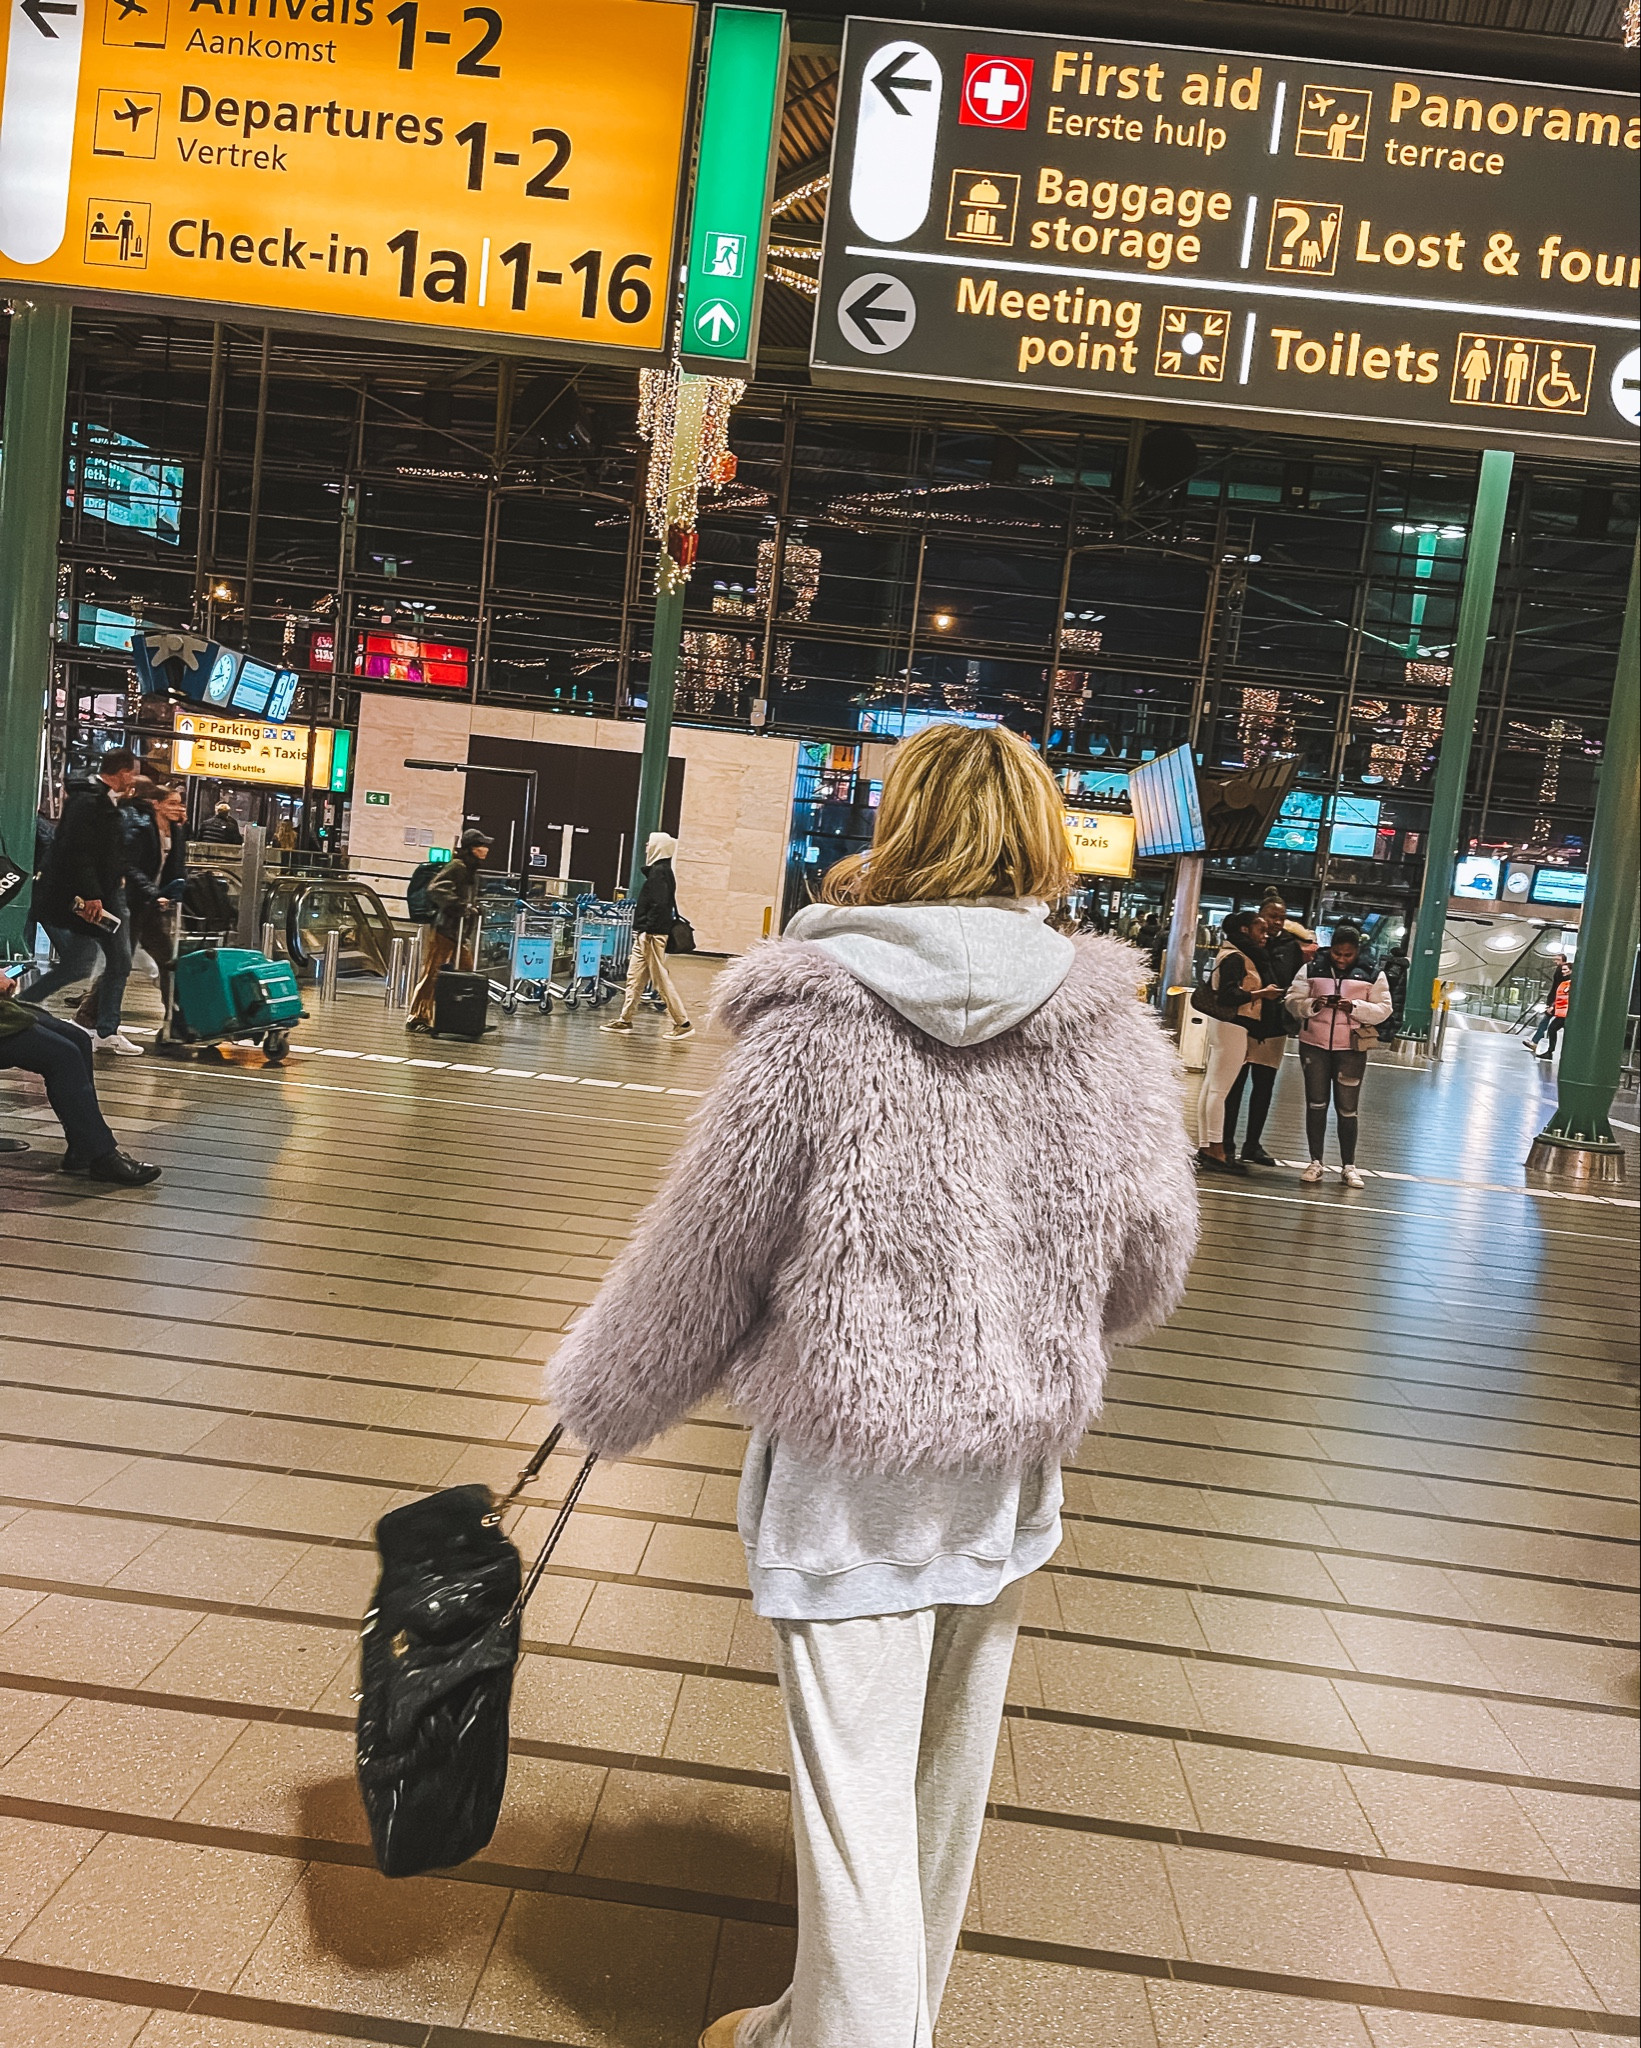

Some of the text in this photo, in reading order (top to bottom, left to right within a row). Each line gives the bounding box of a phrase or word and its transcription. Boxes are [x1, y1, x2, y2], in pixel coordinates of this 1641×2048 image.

[186, 29, 336, 63] Aankomst
[387, 2, 502, 78] 1-2
[1052, 51, 1262, 110] First aid
[1047, 107, 1226, 155] Eerste hulp
[1390, 83, 1640, 149] Panorama
[178, 138, 286, 170] Vertrek
[180, 86, 571, 200] Departures 1-2
[1385, 139, 1504, 174] terrace
[1037, 168, 1231, 226] Baggage
[1031, 219, 1200, 270] storage
[1356, 221, 1465, 270] Lost
[1483, 232, 1520, 275] &
[169, 220, 652, 323] Check-in 1a 1-16
[957, 278, 1141, 335] Meeting
[1018, 332, 1138, 373] point
[1271, 329, 1439, 383] Toilets
[209, 741, 307, 761] Buses Taxis
[210, 723, 260, 740] Parking
[208, 761, 266, 774] Hotel shuttles
[1073, 834, 1109, 849] Taxis
